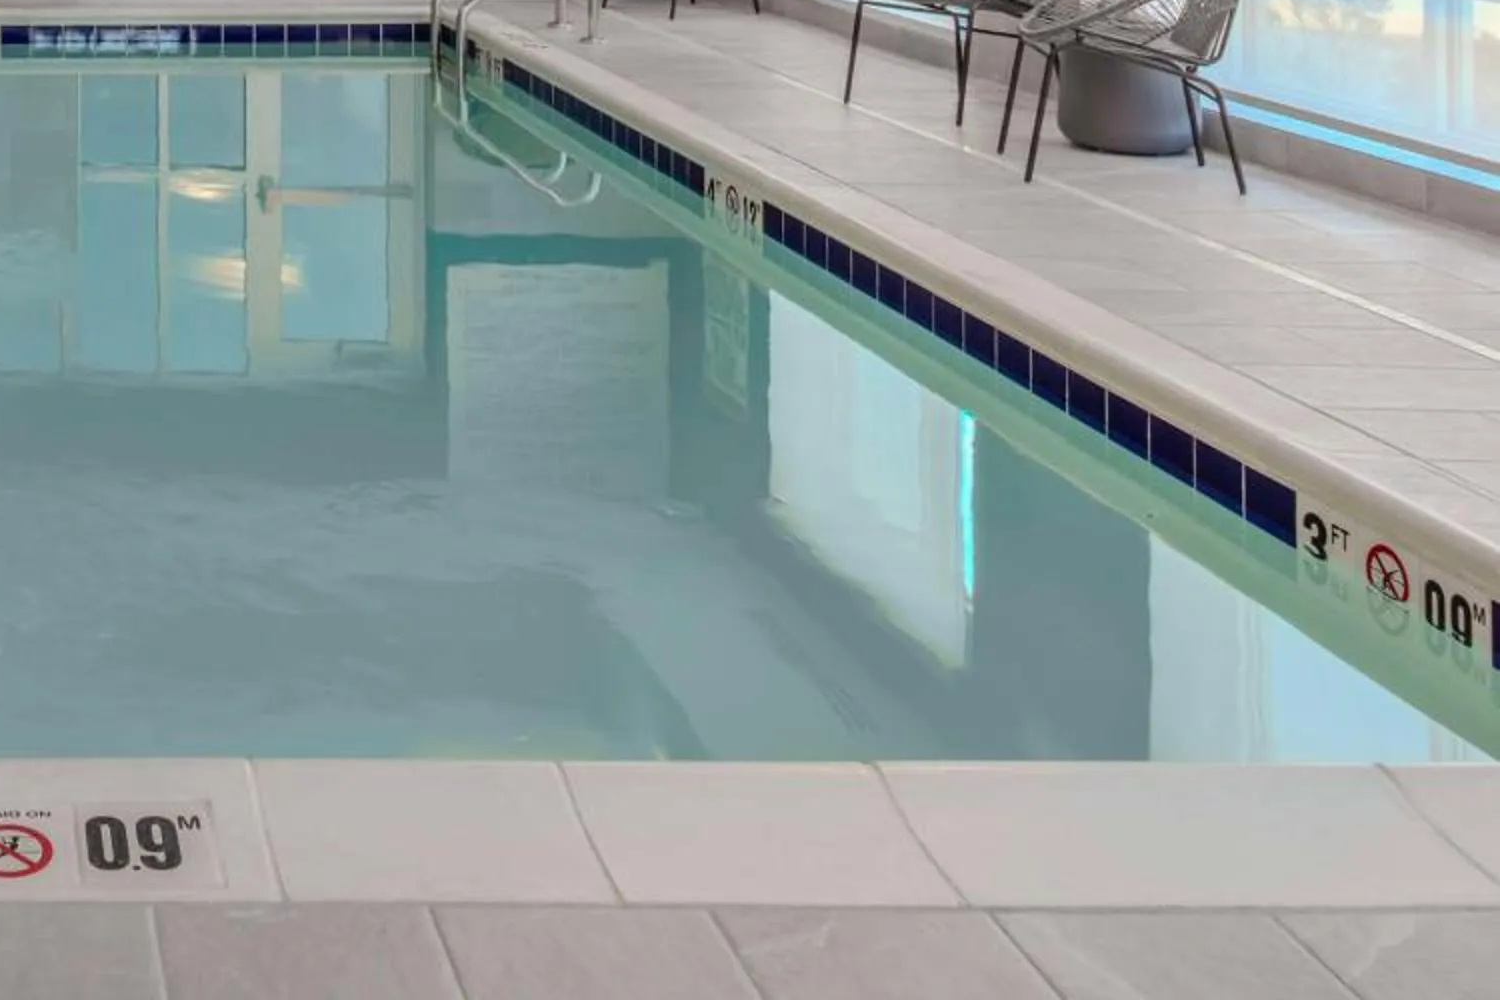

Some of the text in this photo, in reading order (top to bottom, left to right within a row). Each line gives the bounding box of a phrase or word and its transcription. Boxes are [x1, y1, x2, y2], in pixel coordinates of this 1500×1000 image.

[1303, 511, 1351, 561] 3 FT
[26, 809, 52, 819] NO
[85, 815, 201, 871] 0.9 M
